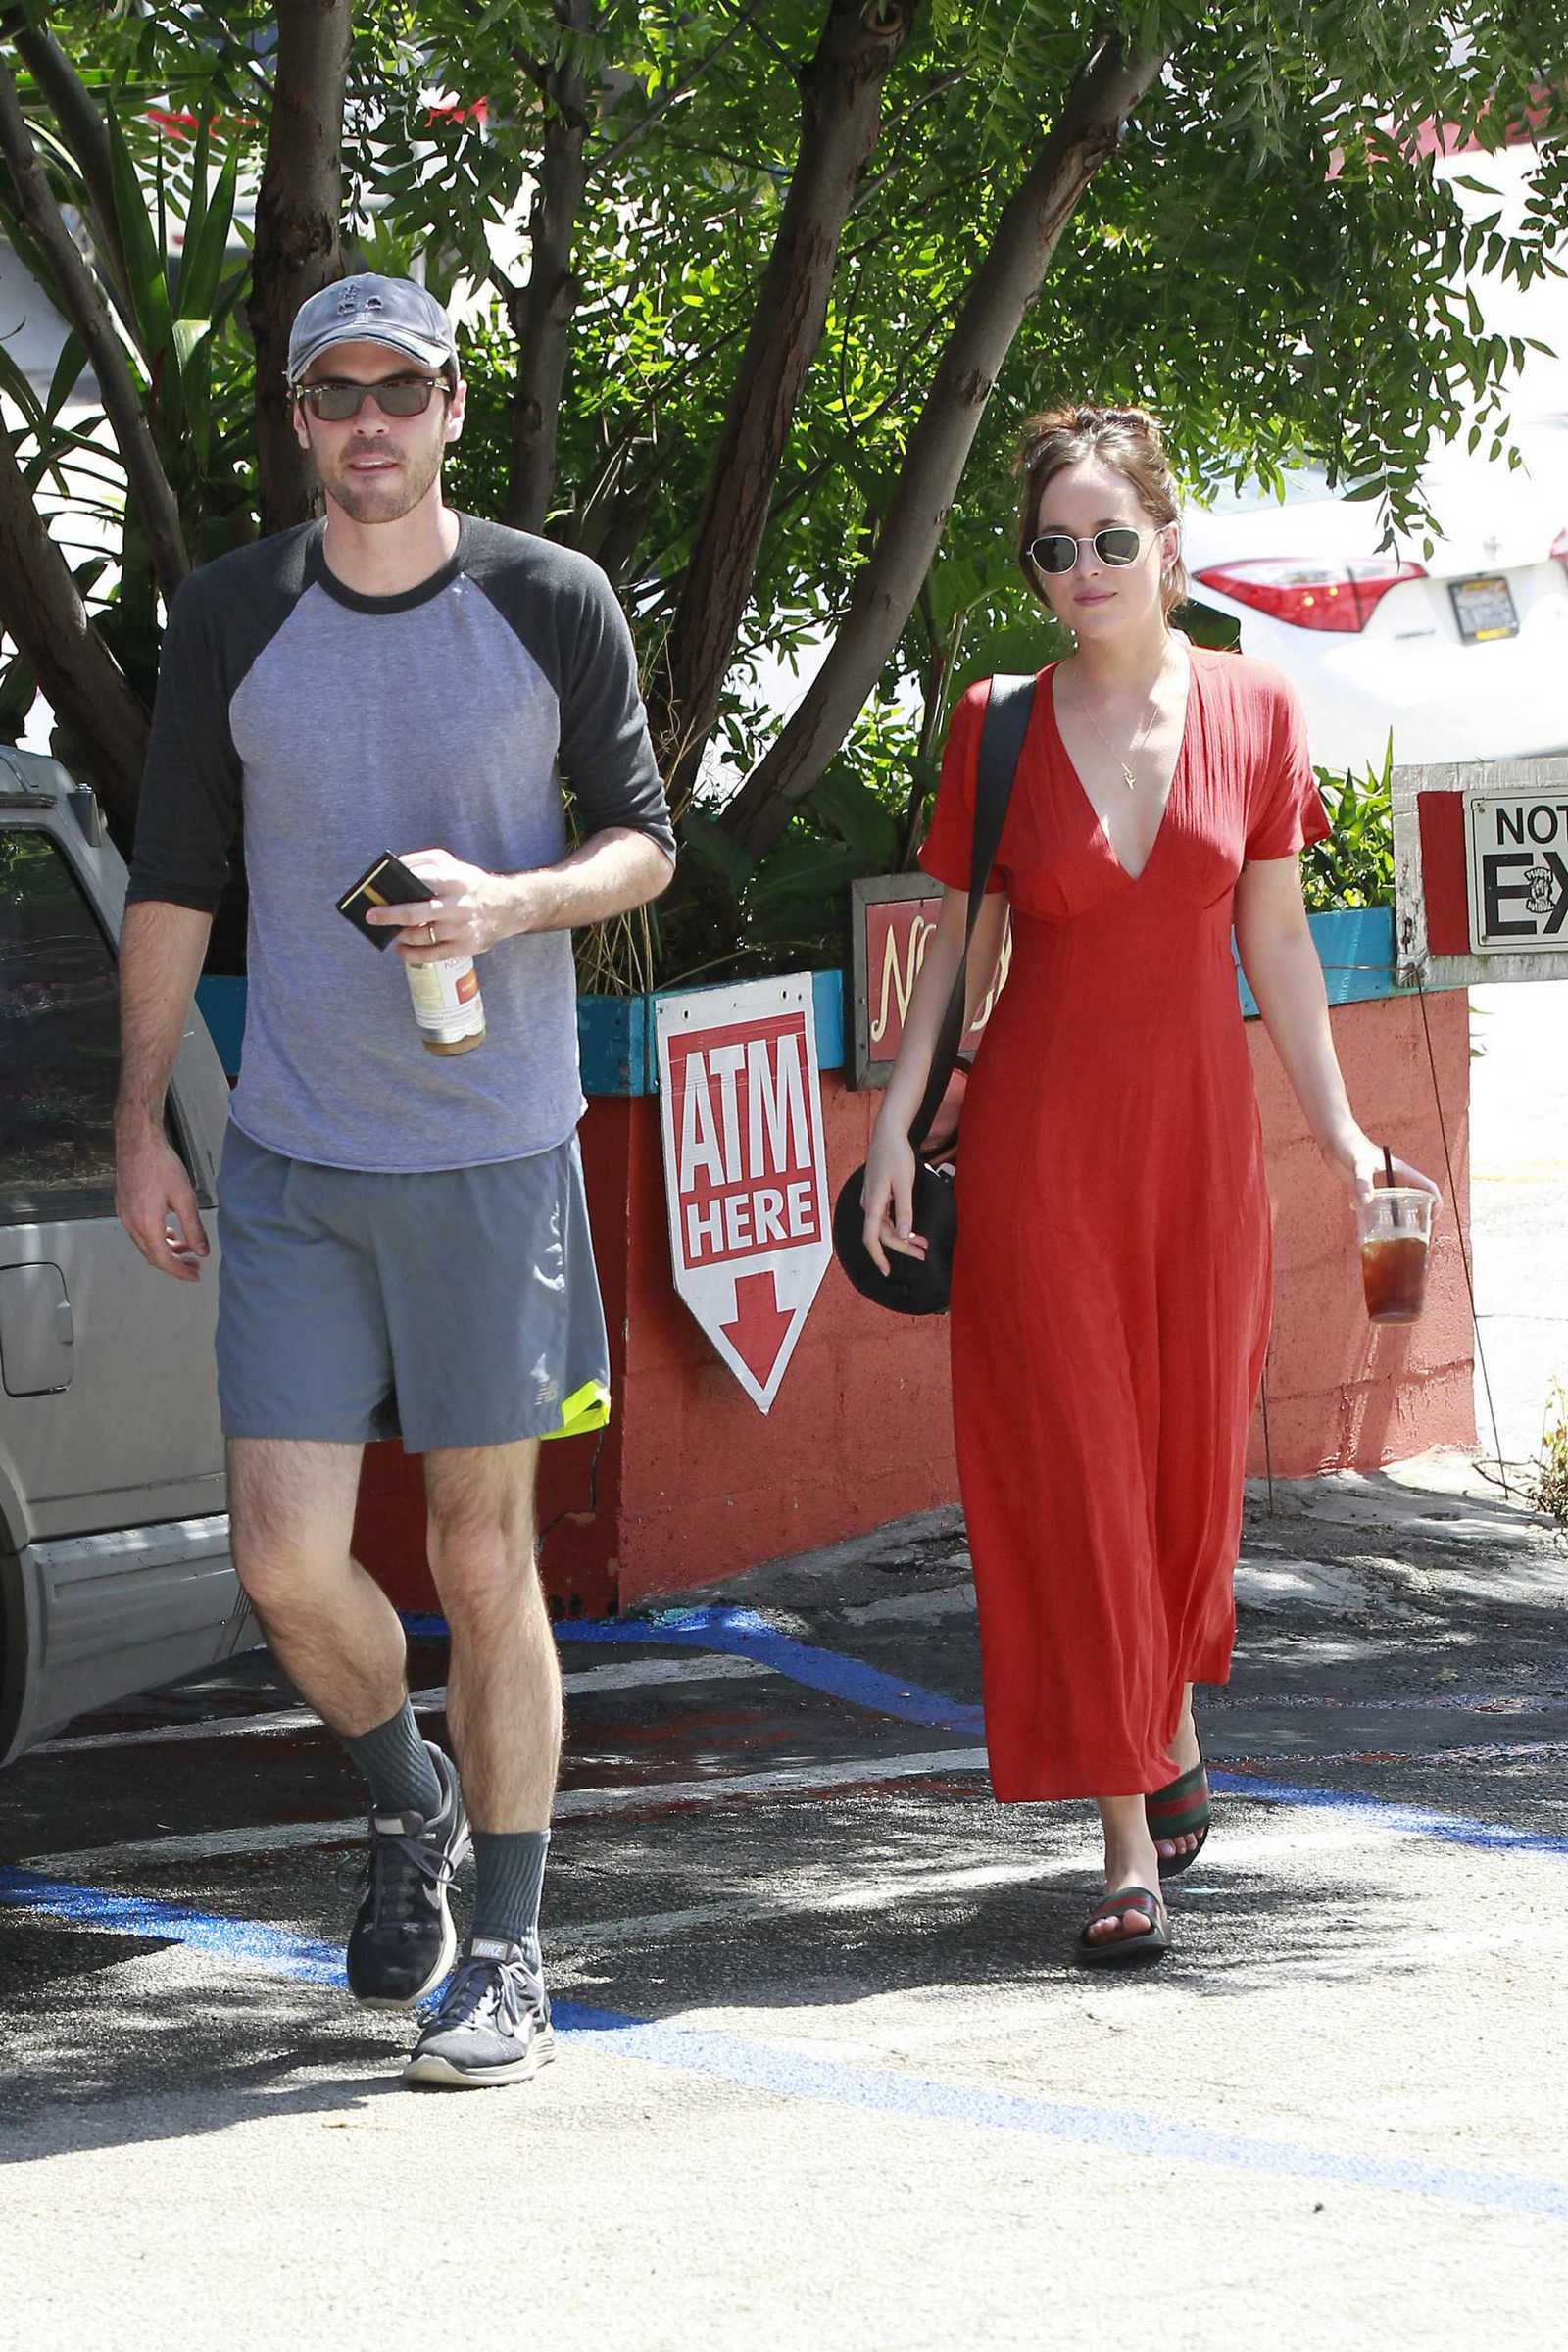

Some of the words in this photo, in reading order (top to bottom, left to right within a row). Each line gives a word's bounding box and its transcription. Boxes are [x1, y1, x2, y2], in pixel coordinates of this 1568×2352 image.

[680, 1034, 812, 1194] ATM
[687, 1180, 815, 1259] HERE
[475, 1942, 504, 1957] NIKE
